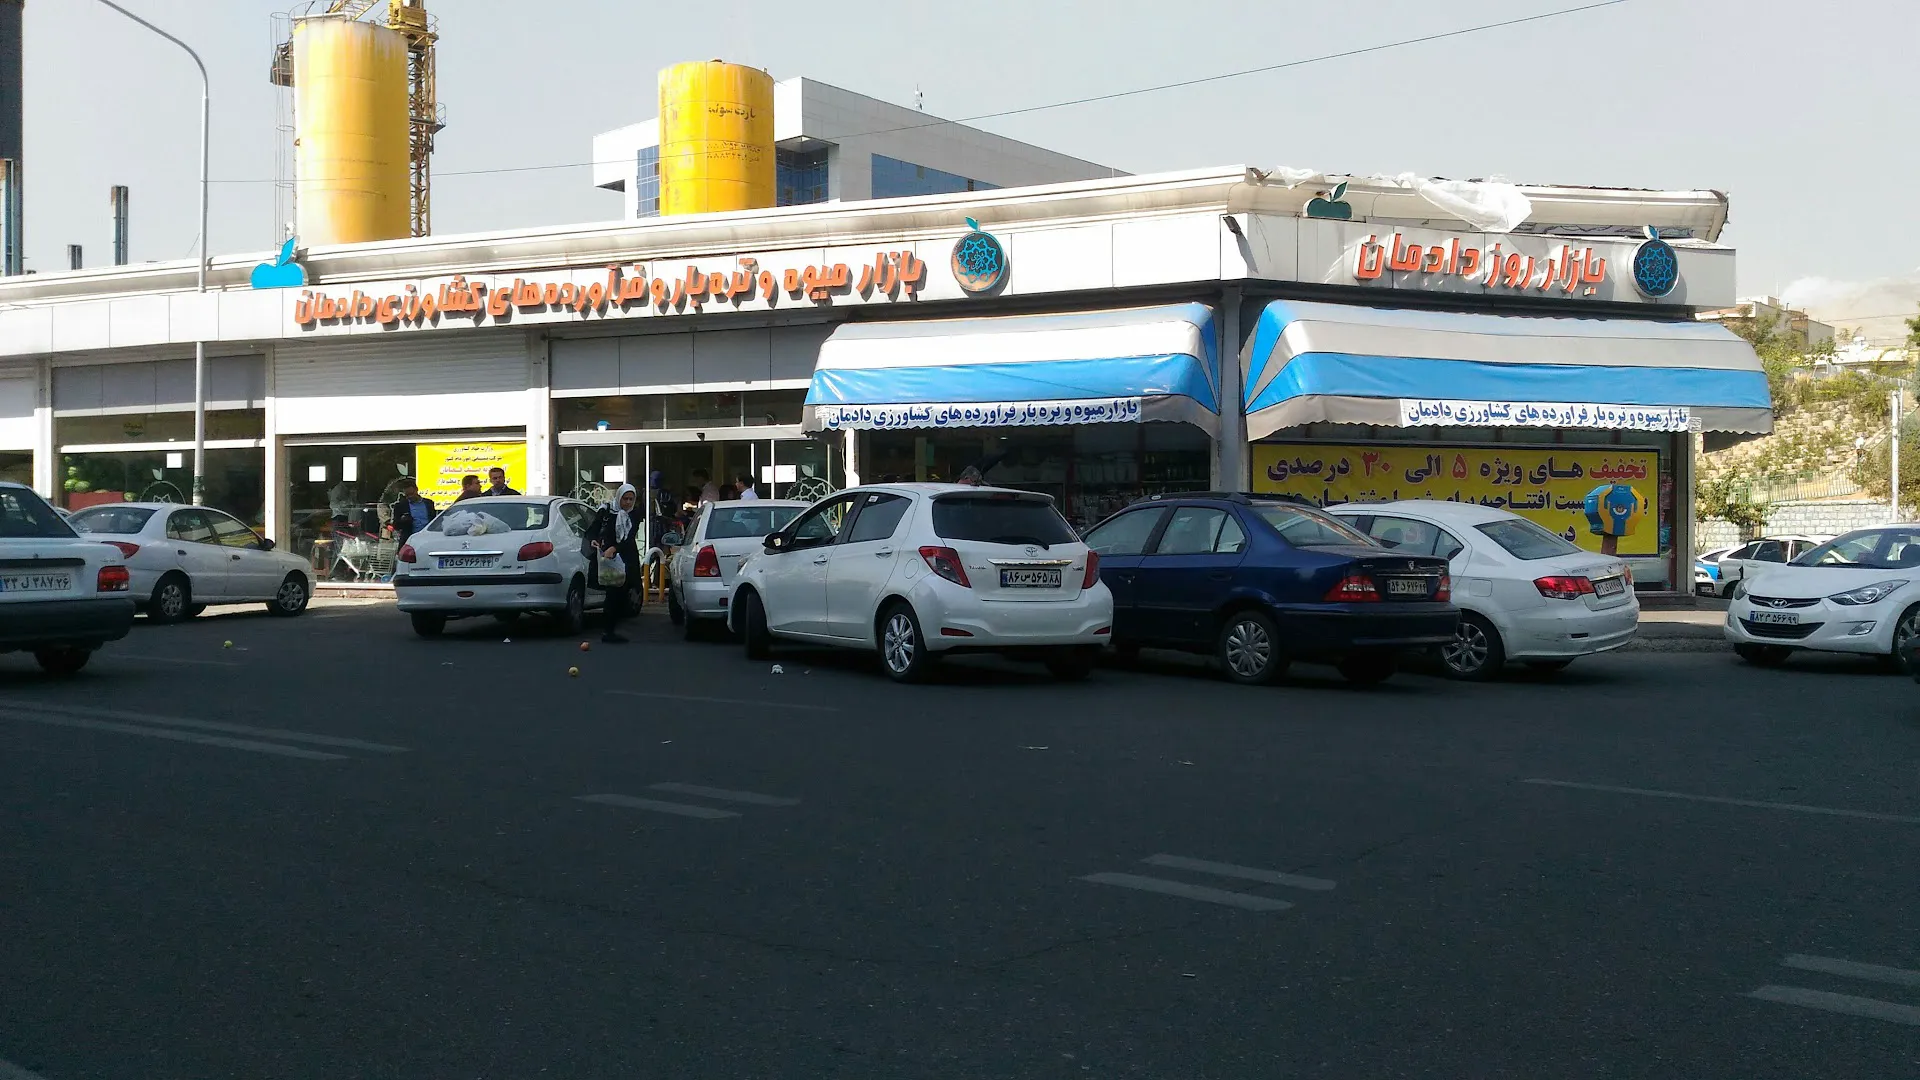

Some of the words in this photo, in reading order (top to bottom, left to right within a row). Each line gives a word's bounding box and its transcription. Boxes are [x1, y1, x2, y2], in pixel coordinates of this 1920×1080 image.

[1357, 232, 1480, 279] دادمان
[1484, 242, 1534, 290] روز
[710, 257, 758, 299] تره
[784, 263, 848, 300] میوه
[856, 250, 922, 294] بازار
[1538, 244, 1606, 297] بازار
[487, 278, 546, 316] های
[650, 277, 666, 306] و
[671, 265, 709, 307] بار
[759, 270, 774, 300] و
[294, 289, 373, 324] دادمان
[376, 274, 485, 324] کشاورزی
[828, 407, 872, 428] دادمان
[873, 406, 933, 428] کشاورزی
[935, 405, 962, 426] های
[1018, 403, 1036, 423] بار
[1040, 402, 1061, 423] تره
[1064, 407, 1072, 422] و
[1075, 404, 1105, 422] میوه
[1105, 399, 1138, 420] بازار
[1407, 400, 1452, 422] دادمان
[1453, 402, 1511, 423] کشاورزی
[1514, 403, 1540, 424] های
[1593, 405, 1606, 425] بار
[1608, 406, 1626, 426] تره
[1629, 412, 1637, 427] و
[1638, 412, 1662, 427] میوه
[1663, 408, 1688, 428] بازار
[1266, 455, 1350, 482] درصدی
[1362, 452, 1392, 478] ۳۰
[1405, 454, 1441, 485] الی
[1451, 453, 1468, 479] ۵
[1479, 457, 1523, 486] ویژه
[1528, 457, 1584, 486] های
[1589, 452, 1648, 487] تخفیف
